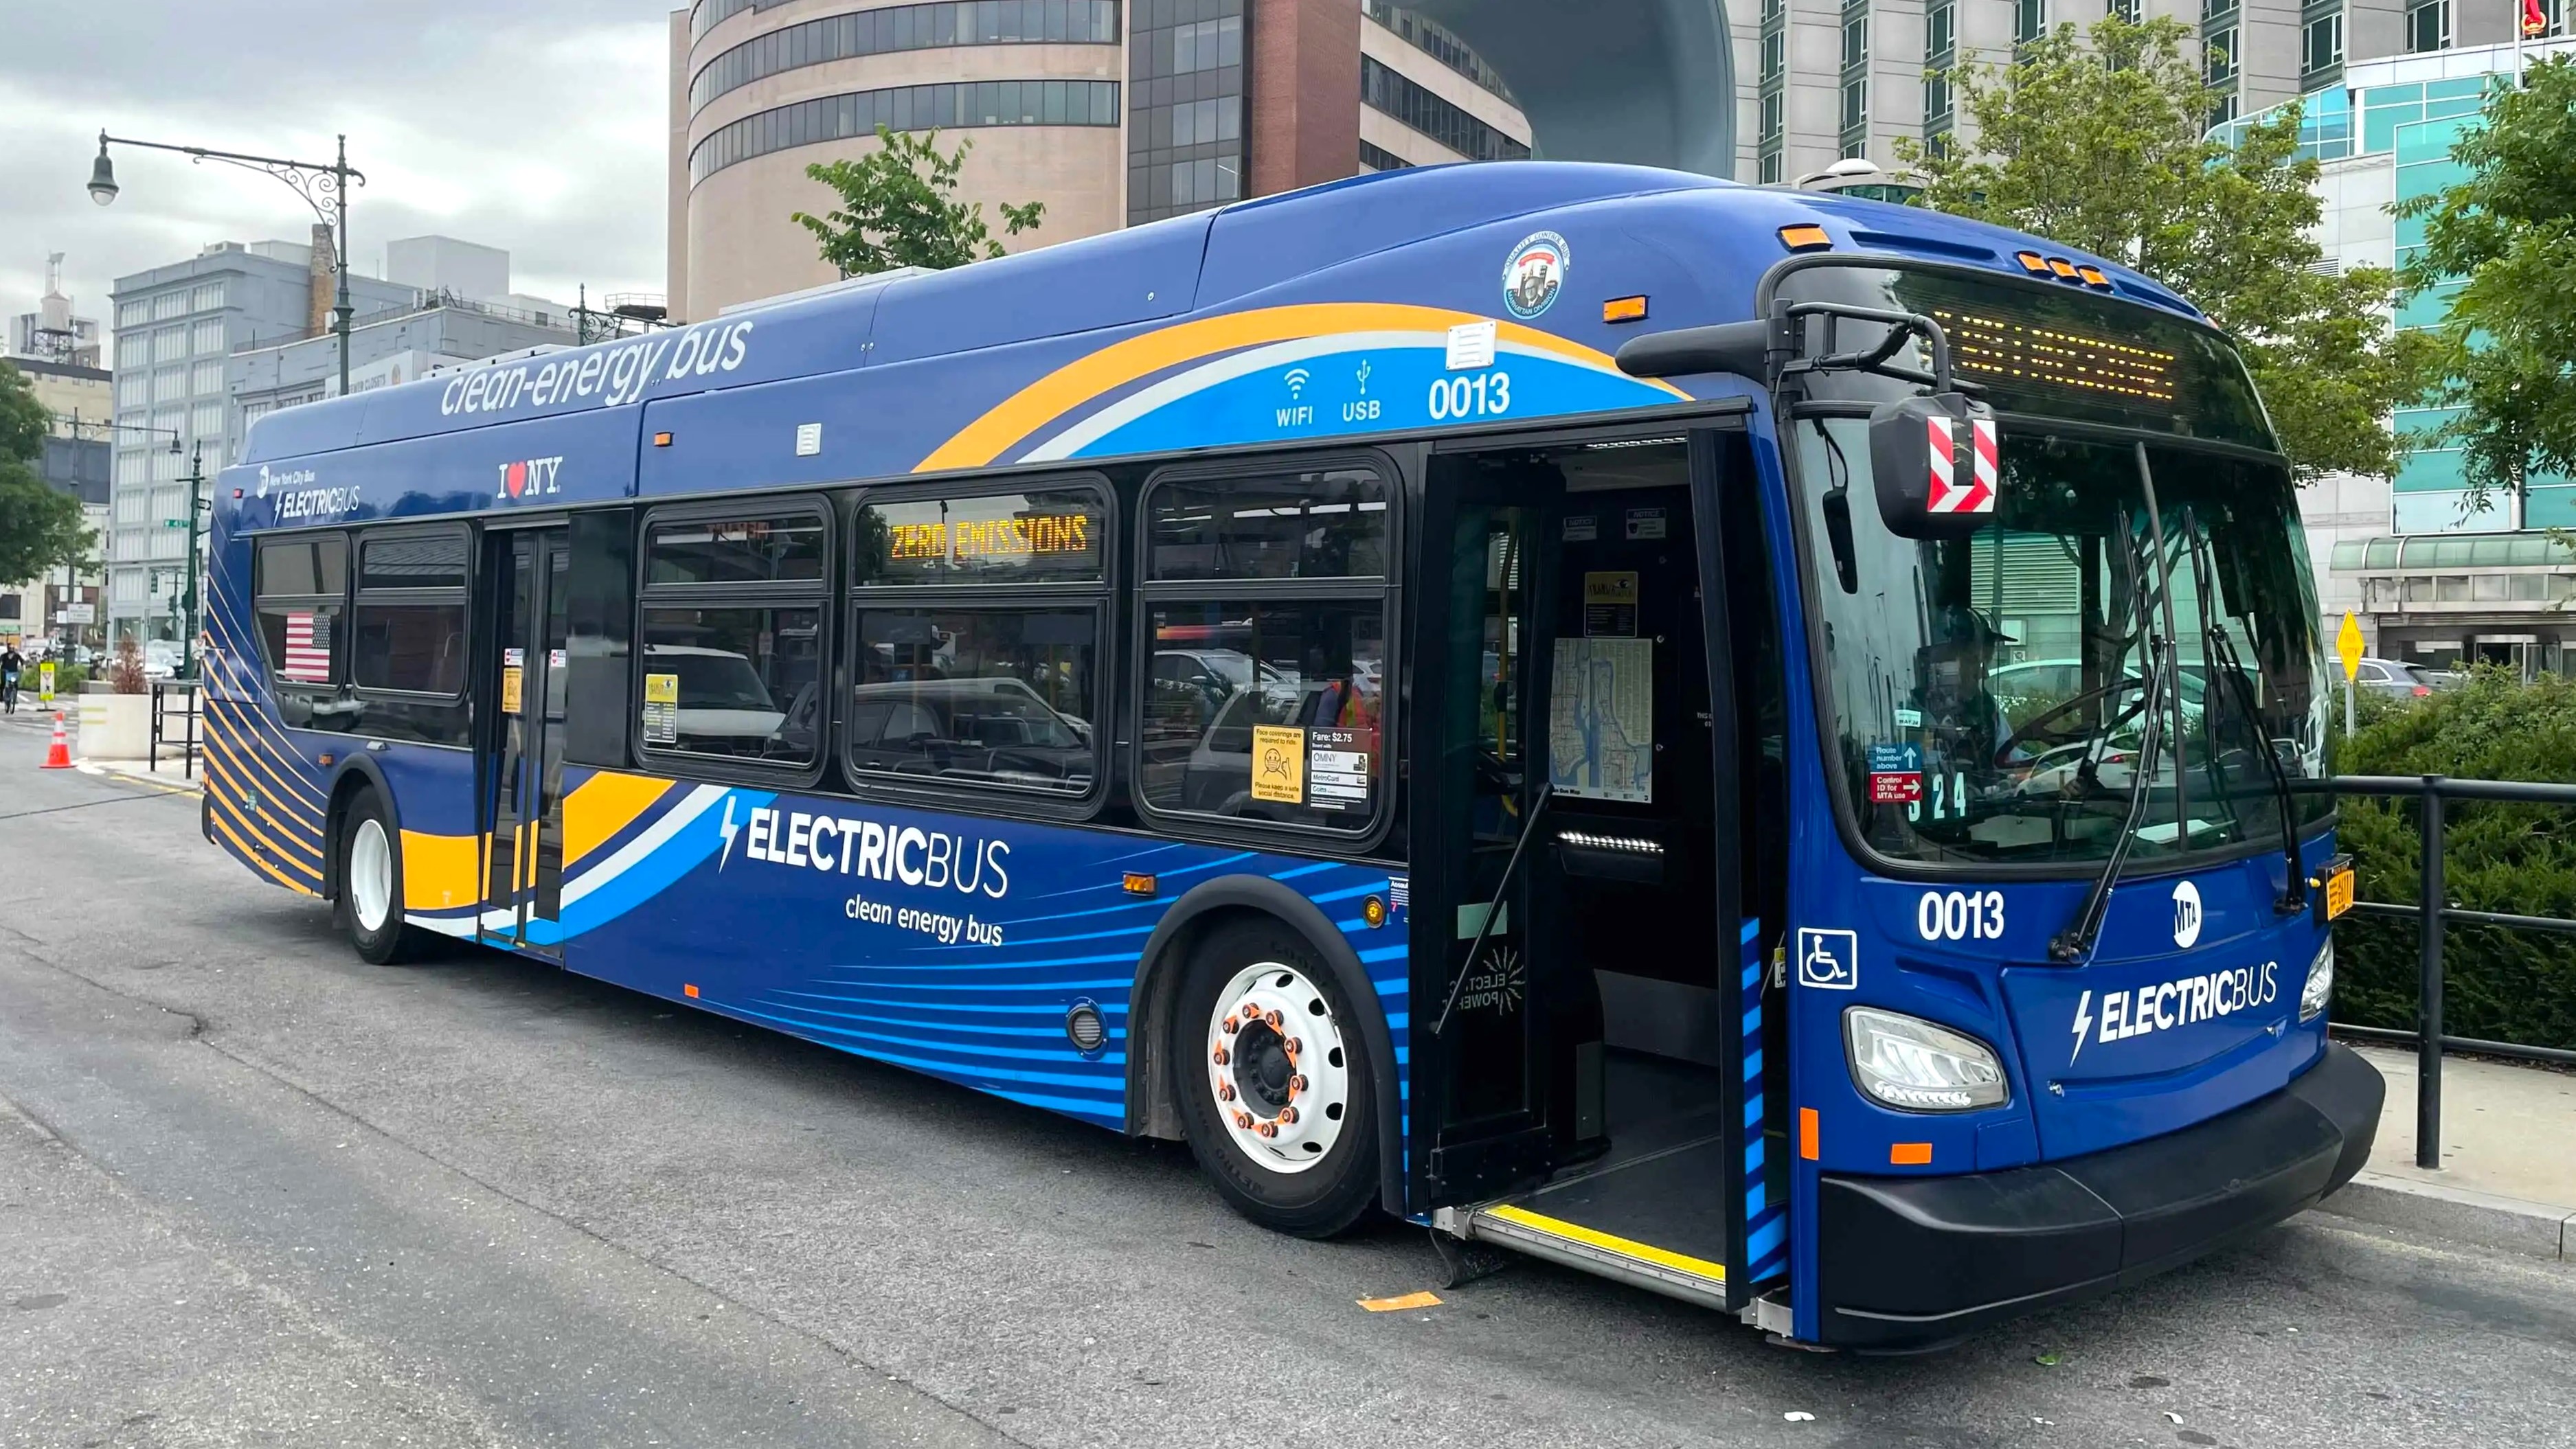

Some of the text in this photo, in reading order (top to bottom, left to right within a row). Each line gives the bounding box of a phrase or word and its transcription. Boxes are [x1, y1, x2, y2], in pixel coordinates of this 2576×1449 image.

[1505, 236, 1533, 267] QUALITY
[1534, 232, 1562, 245] CONTROL
[1561, 242, 1571, 259] BUS
[1507, 287, 1556, 315] MANHATTAN DIVISION
[441, 321, 754, 416] clean-energy bus
[1428, 371, 1511, 420] 0013
[1276, 400, 1381, 427] WIFI USB
[269, 469, 315, 486] New York City Bus
[497, 464, 508, 499] I
[892, 515, 1087, 558] ZERO EMISSIONS
[1568, 518, 1594, 527] NOTICE
[1312, 731, 1353, 742] Fare: $2.75
[1313, 752, 1337, 762] OMNY
[1313, 773, 1340, 782] MetroCard
[746, 807, 1010, 898] ELECTRICBUS
[846, 893, 1003, 946] clean energy bus
[1918, 891, 2004, 941] 0013
[2173, 897, 2198, 938] MTA
[2099, 961, 2278, 1045] ELECTRICBUS
